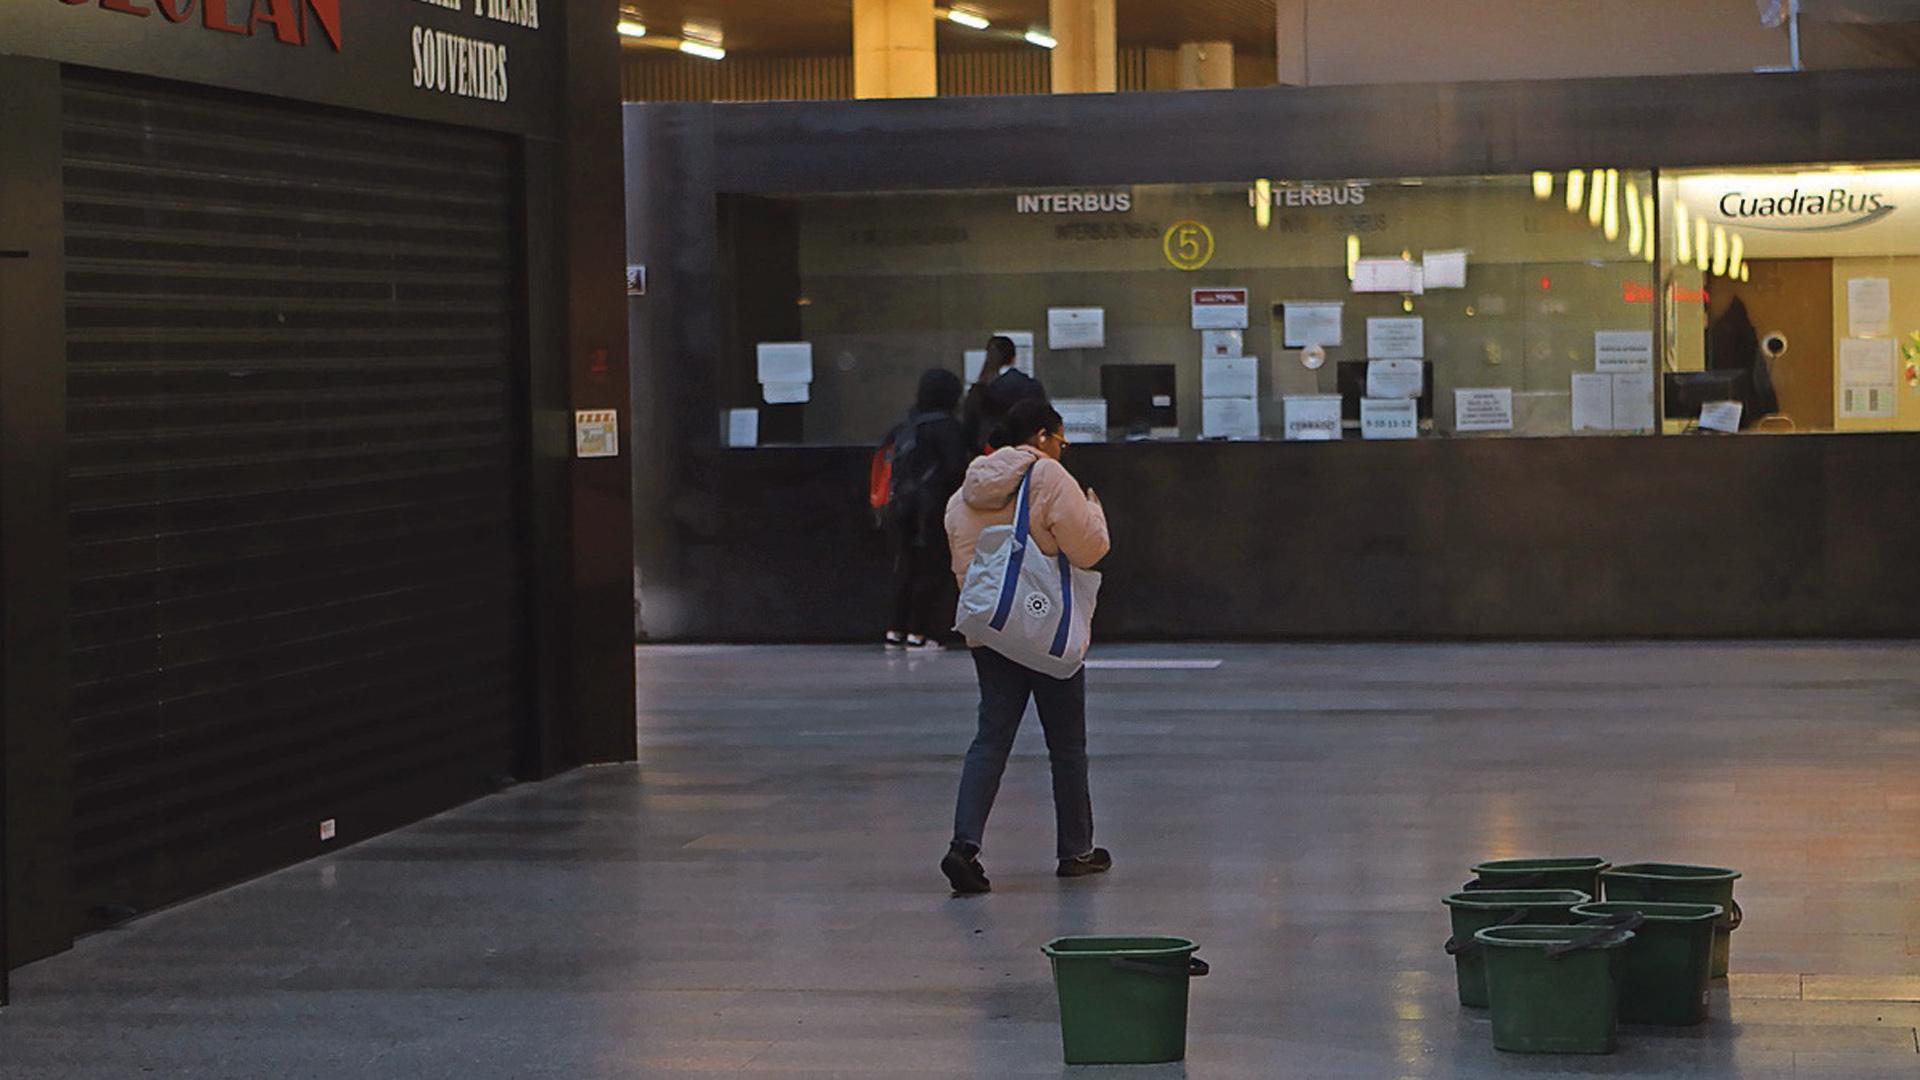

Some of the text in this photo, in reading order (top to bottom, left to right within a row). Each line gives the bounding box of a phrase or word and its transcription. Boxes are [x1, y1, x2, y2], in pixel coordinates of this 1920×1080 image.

[412, 25, 508, 102] SOUVENIRS
[1016, 193, 1131, 213] INTERBUS
[1719, 188, 1883, 218] CuadraBus
